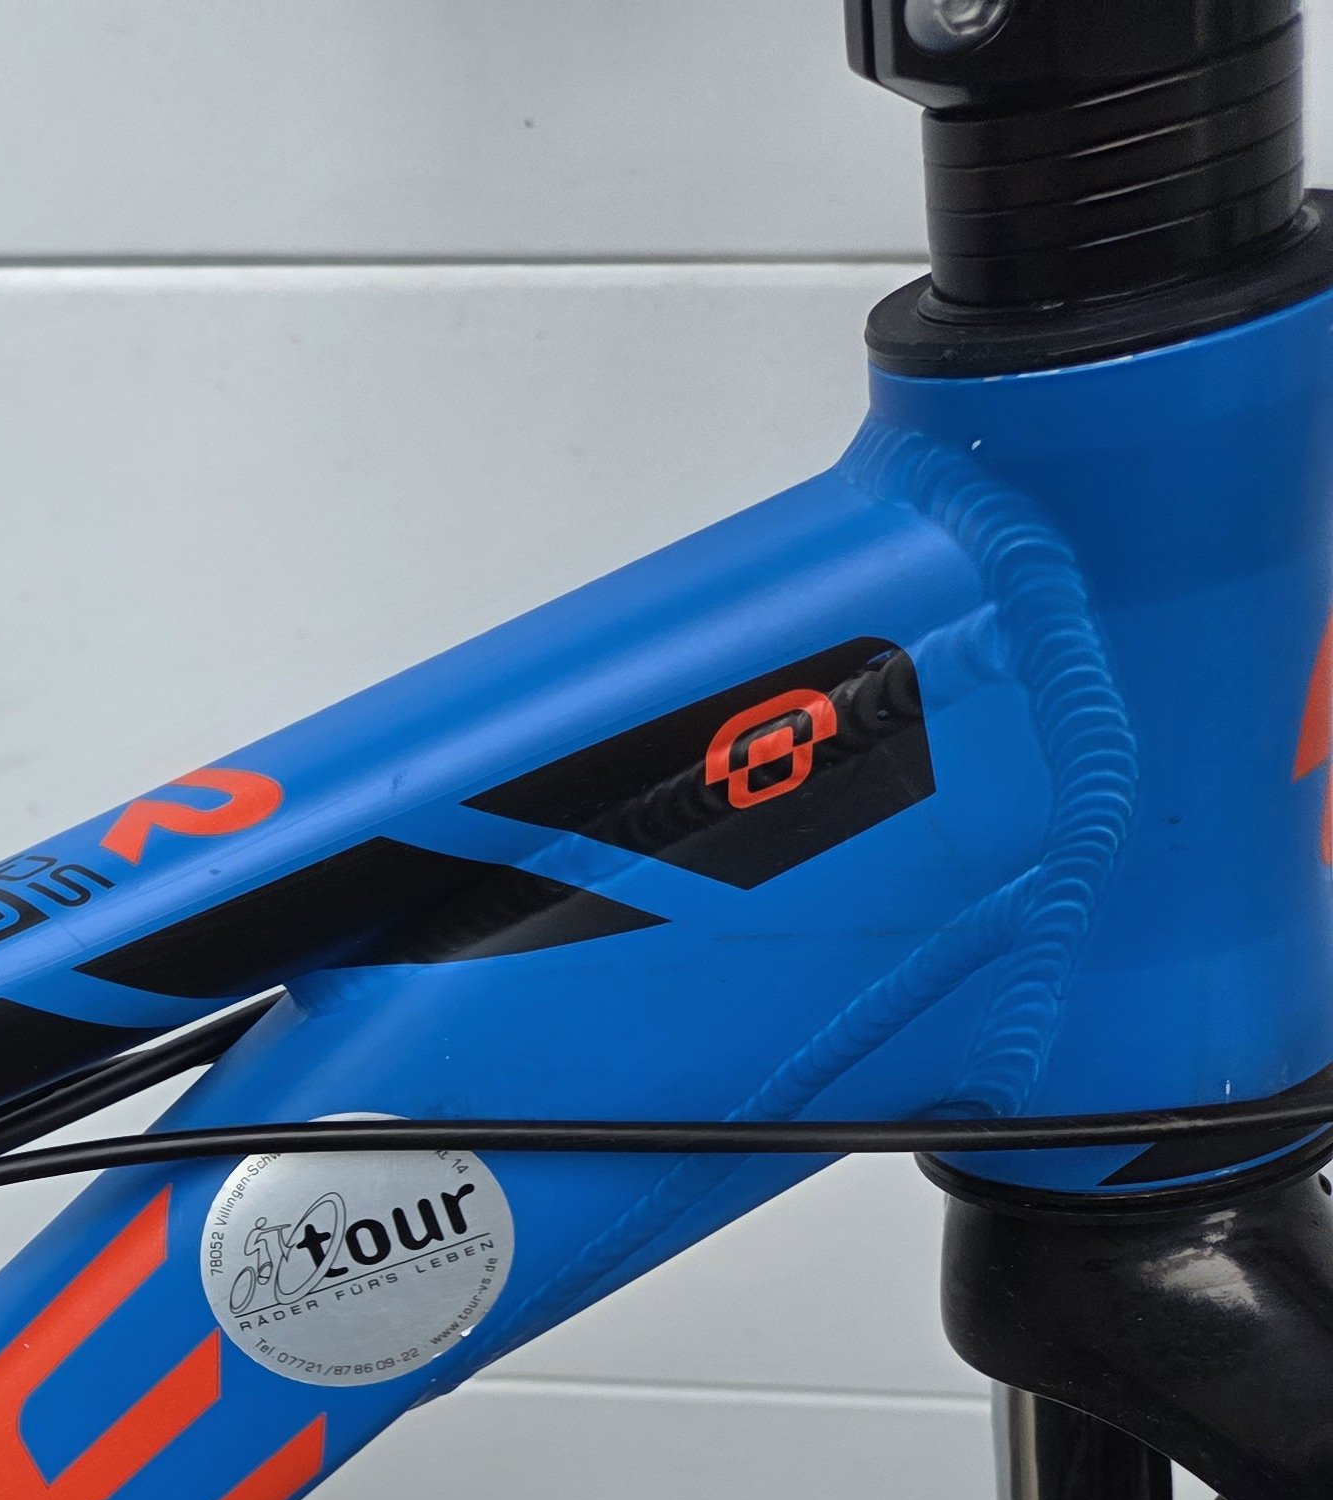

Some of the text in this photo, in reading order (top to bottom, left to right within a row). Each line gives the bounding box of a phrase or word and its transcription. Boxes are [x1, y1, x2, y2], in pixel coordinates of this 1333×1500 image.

[210, 1153, 469, 1276] 78052 Villingen-Sch 14
[296, 1183, 475, 1278] tour
[239, 1299, 319, 1332] RÄDER
[414, 1239, 495, 1274] LEBEN
[430, 1257, 499, 1345] www.tour-vs.de
